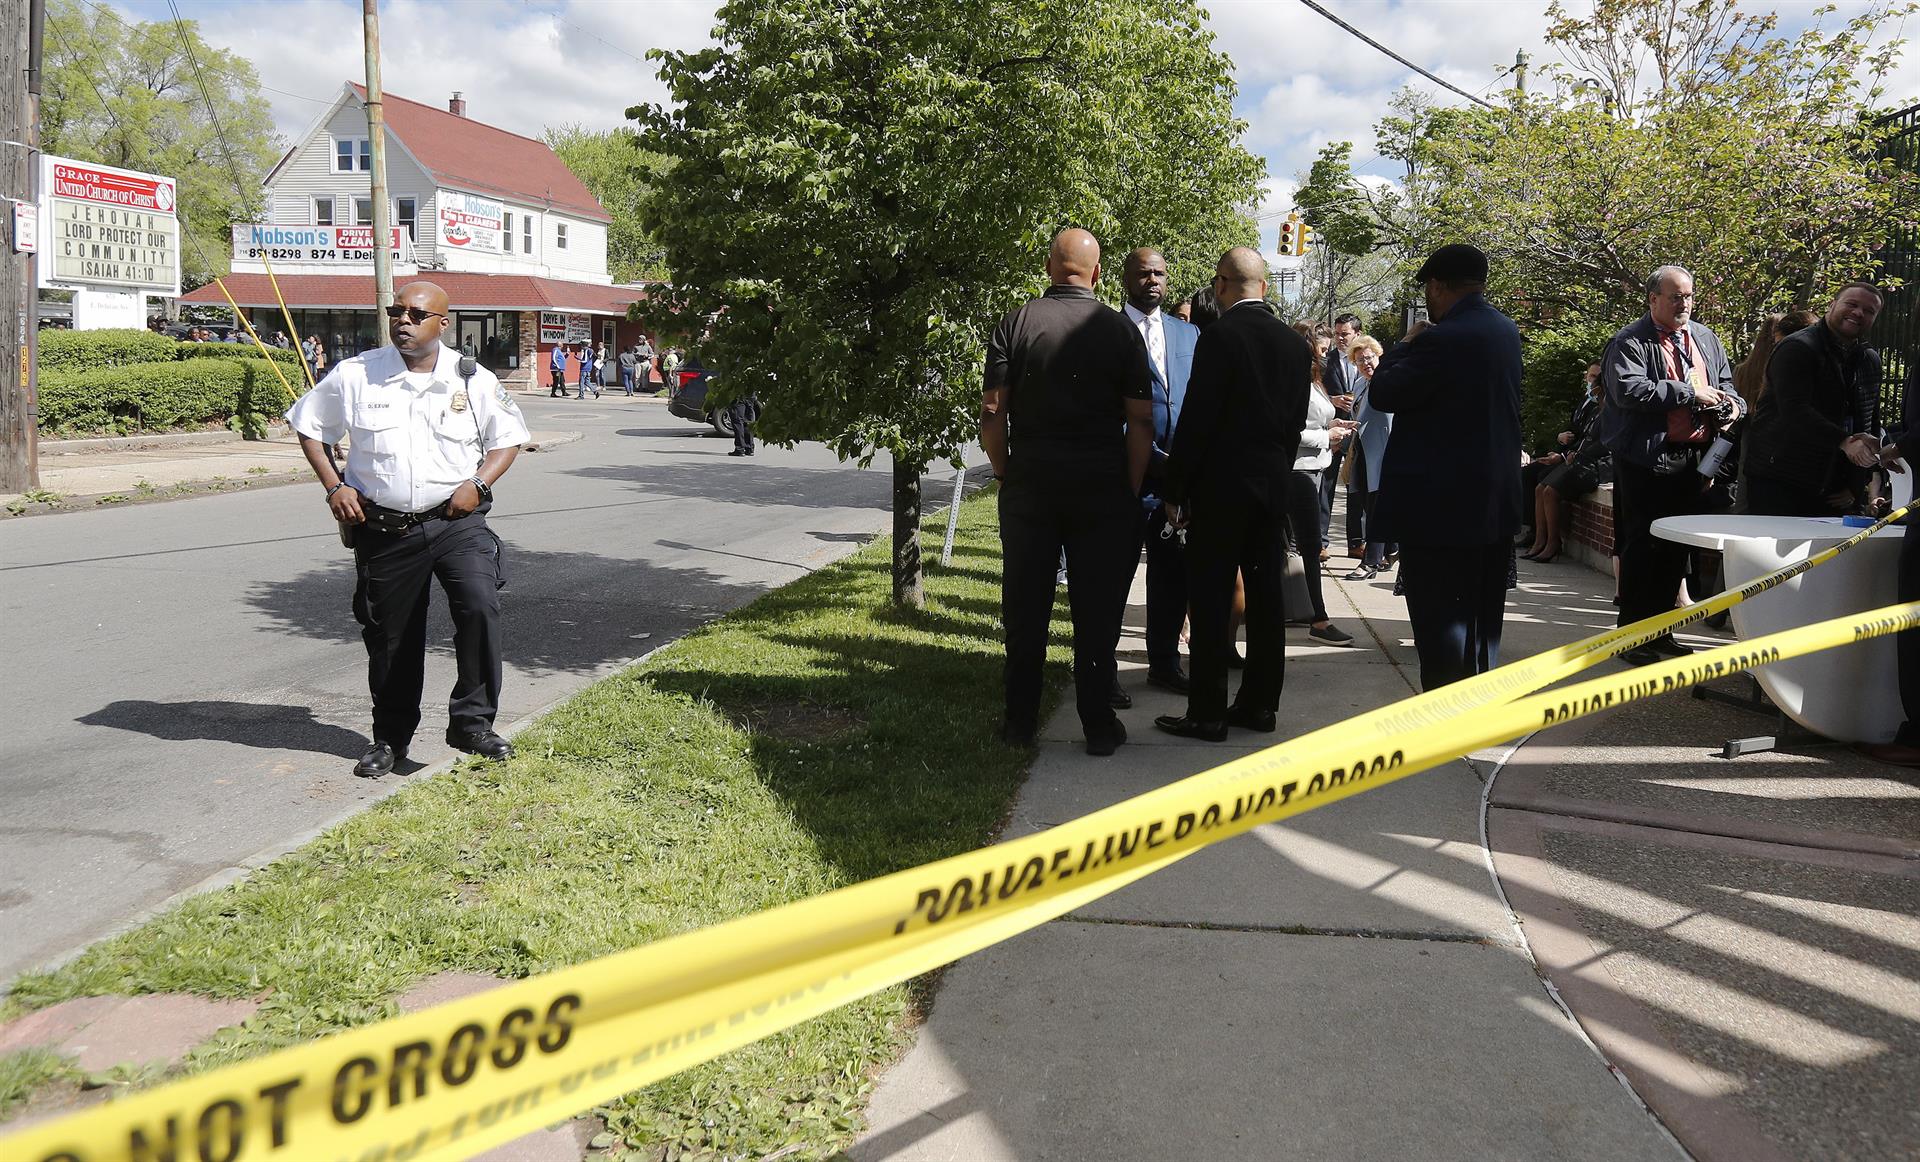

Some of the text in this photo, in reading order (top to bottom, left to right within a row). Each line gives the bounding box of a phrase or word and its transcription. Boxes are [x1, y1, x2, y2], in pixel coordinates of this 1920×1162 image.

[56, 166, 100, 183] GRACE
[56, 178, 85, 197] UNITED
[86, 183, 118, 201] CHURCH
[129, 190, 155, 207] CHRIST
[464, 195, 501, 219] Hobson's
[72, 205, 154, 230] JEHOVAH
[65, 223, 166, 249] LORD PROTECT OUR
[251, 226, 329, 246] Hobson's
[337, 236, 396, 247] CLEANS
[342, 229, 371, 237] DRIVE
[65, 241, 166, 265] COMMUNITY
[311, 249, 336, 259] 874
[81, 261, 154, 281] ISAIAH 41:10
[543, 313, 558, 324] DRIVE
[560, 314, 566, 325] IN
[543, 330, 566, 340] WINDOW
[129, 1075, 306, 1162] NOT
[330, 993, 583, 1125] CROSS
